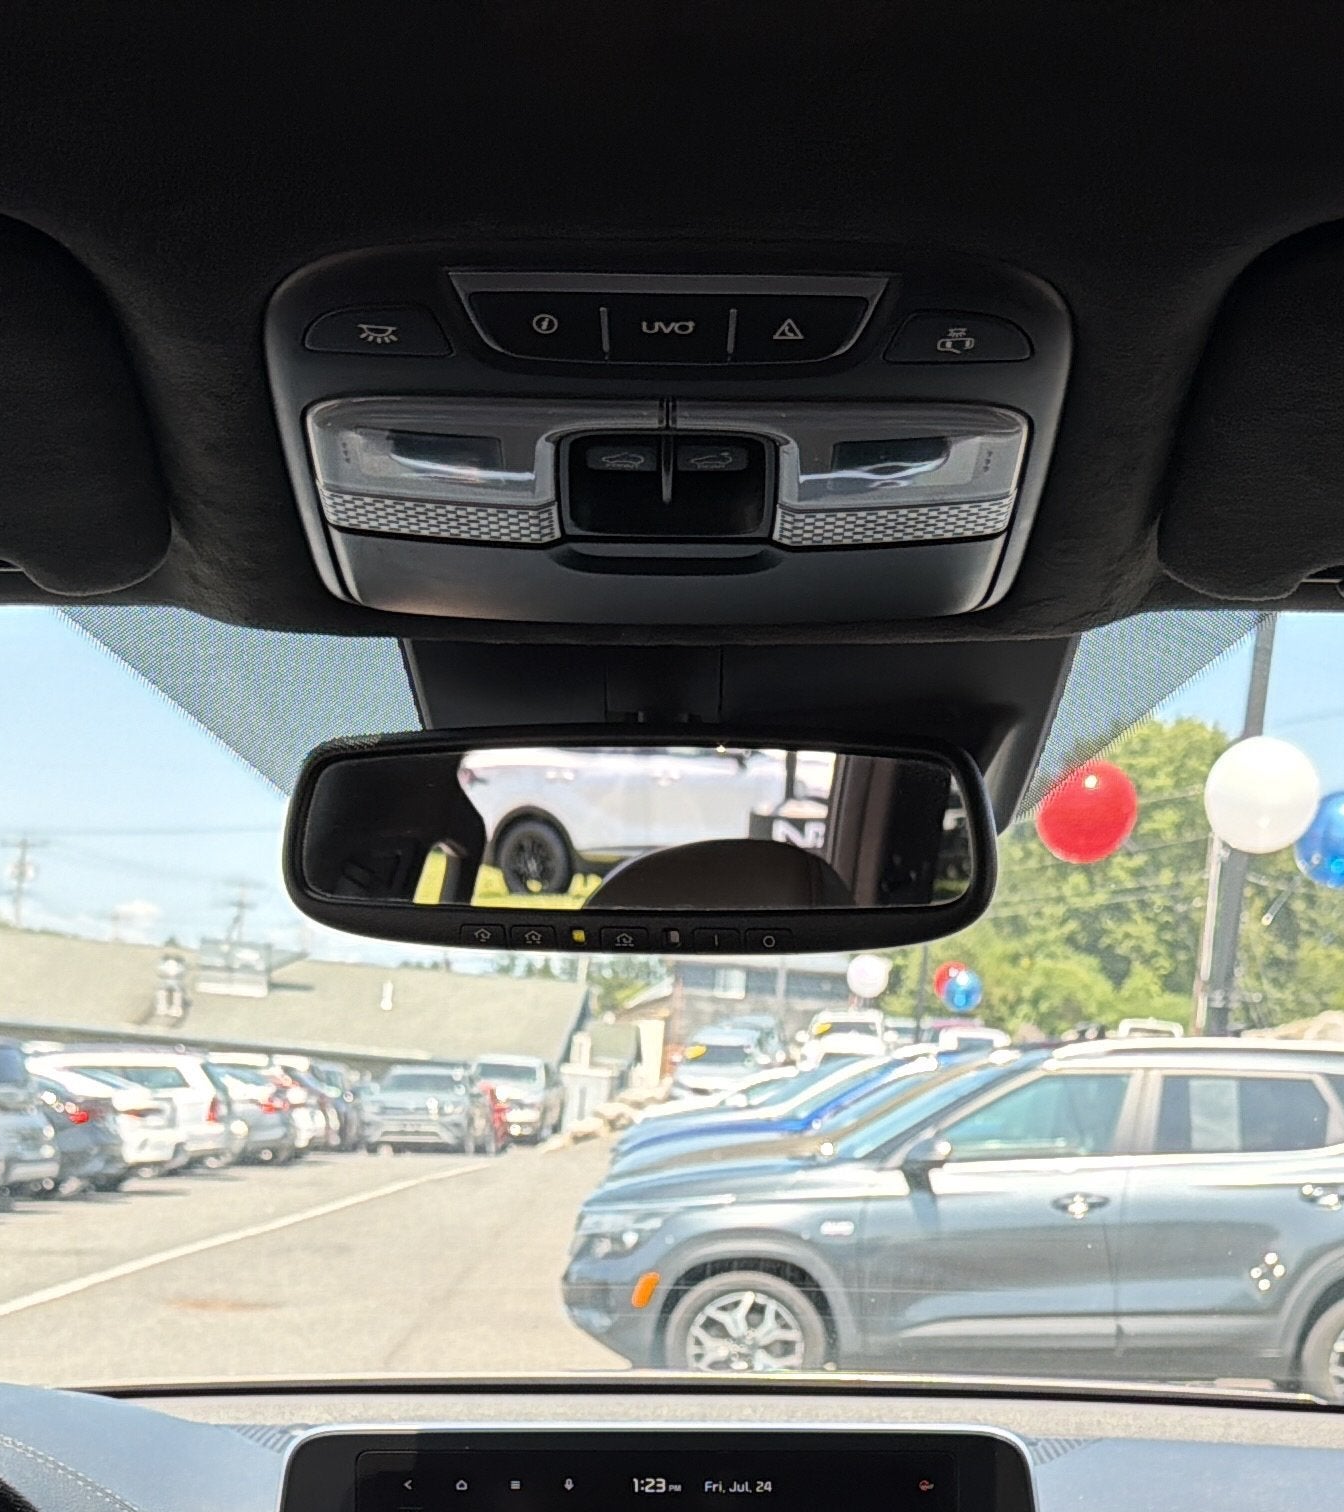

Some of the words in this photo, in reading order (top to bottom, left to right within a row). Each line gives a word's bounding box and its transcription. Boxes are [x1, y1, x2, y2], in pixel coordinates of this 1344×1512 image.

[633, 1478, 666, 1493] 1:23
[668, 1484, 682, 1492] PM
[756, 1481, 773, 1492] 24
